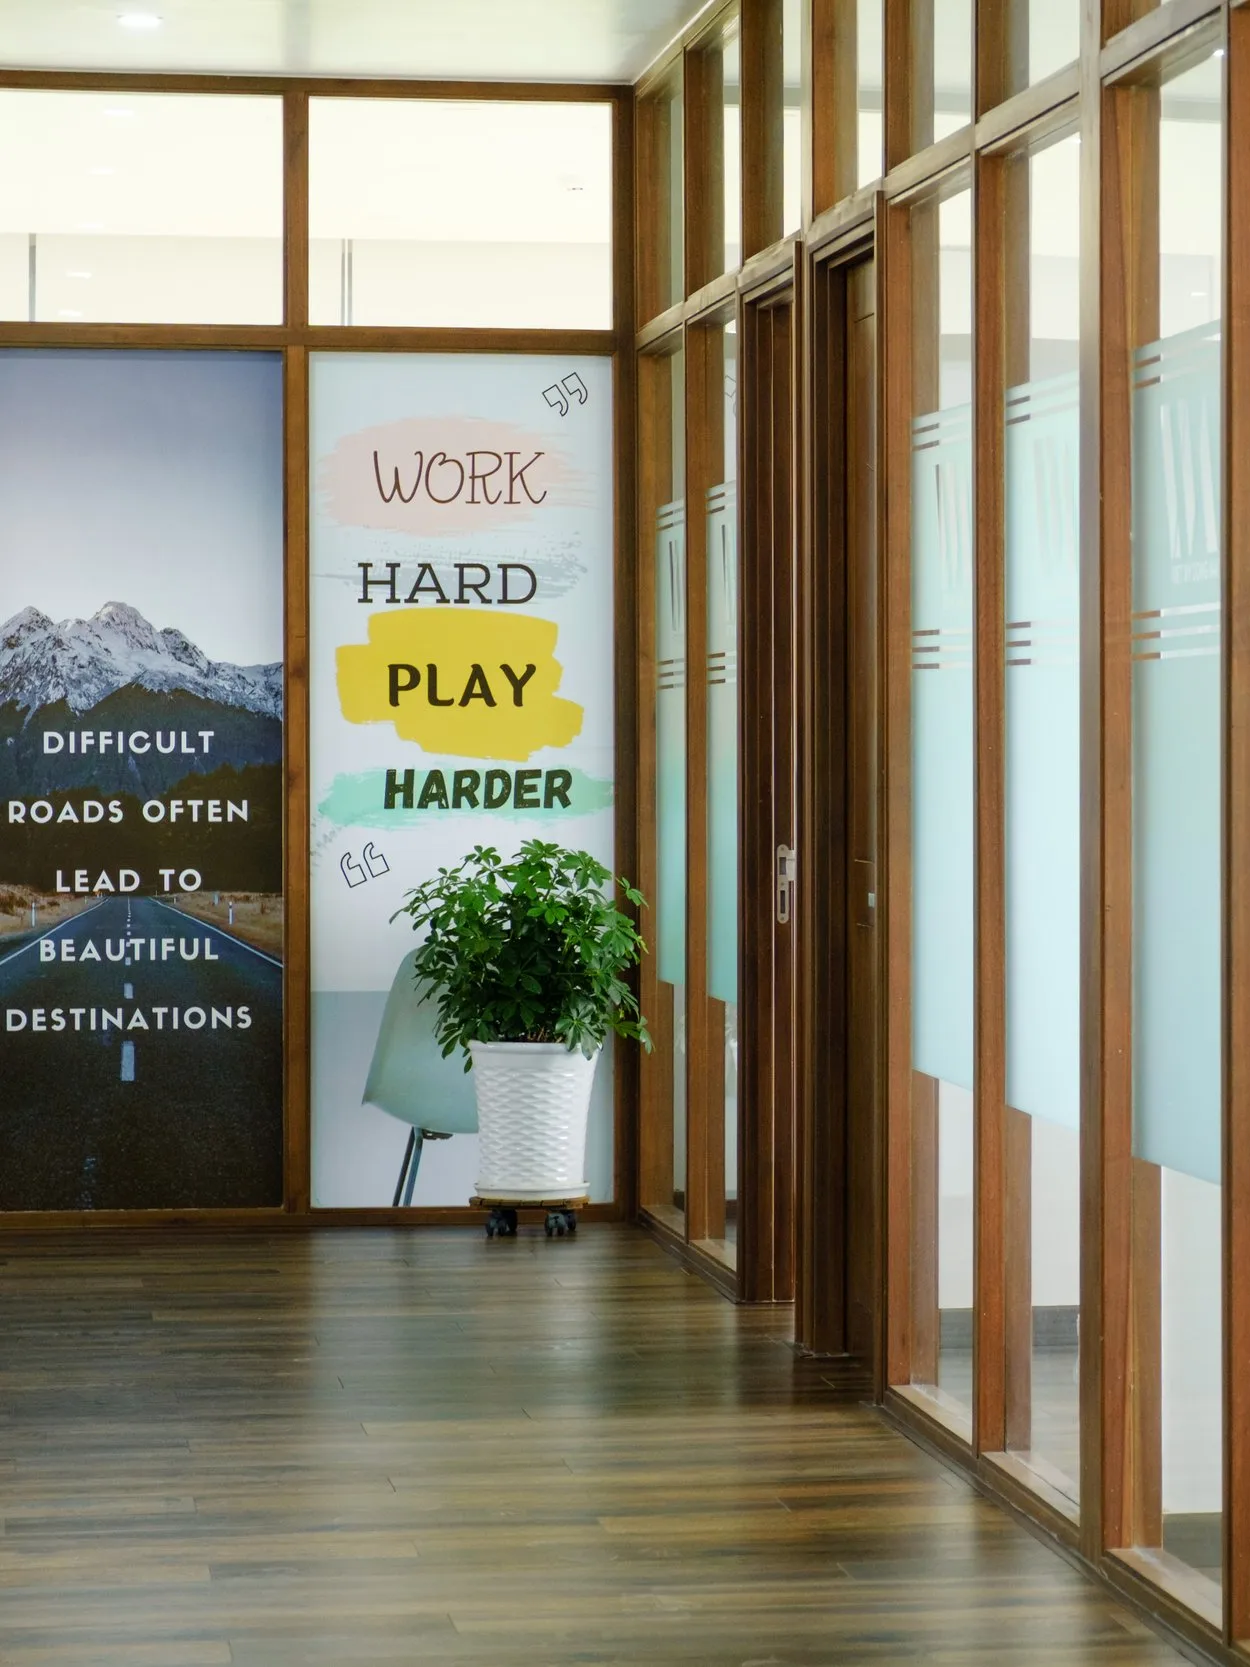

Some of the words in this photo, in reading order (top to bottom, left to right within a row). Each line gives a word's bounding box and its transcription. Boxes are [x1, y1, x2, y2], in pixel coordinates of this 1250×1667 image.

[374, 450, 547, 505] WORK
[357, 562, 537, 605] HARD
[387, 663, 537, 708] PLAY
[43, 730, 215, 754] DIFFICULT
[384, 768, 573, 810] HARDER
[8, 799, 124, 824] ROADS
[142, 799, 249, 823] OFTEN
[56, 869, 140, 893] LEAD
[158, 868, 202, 892] TO
[39, 937, 219, 962] BEAUTIFUL
[6, 1006, 252, 1032] DESTINATIONS
